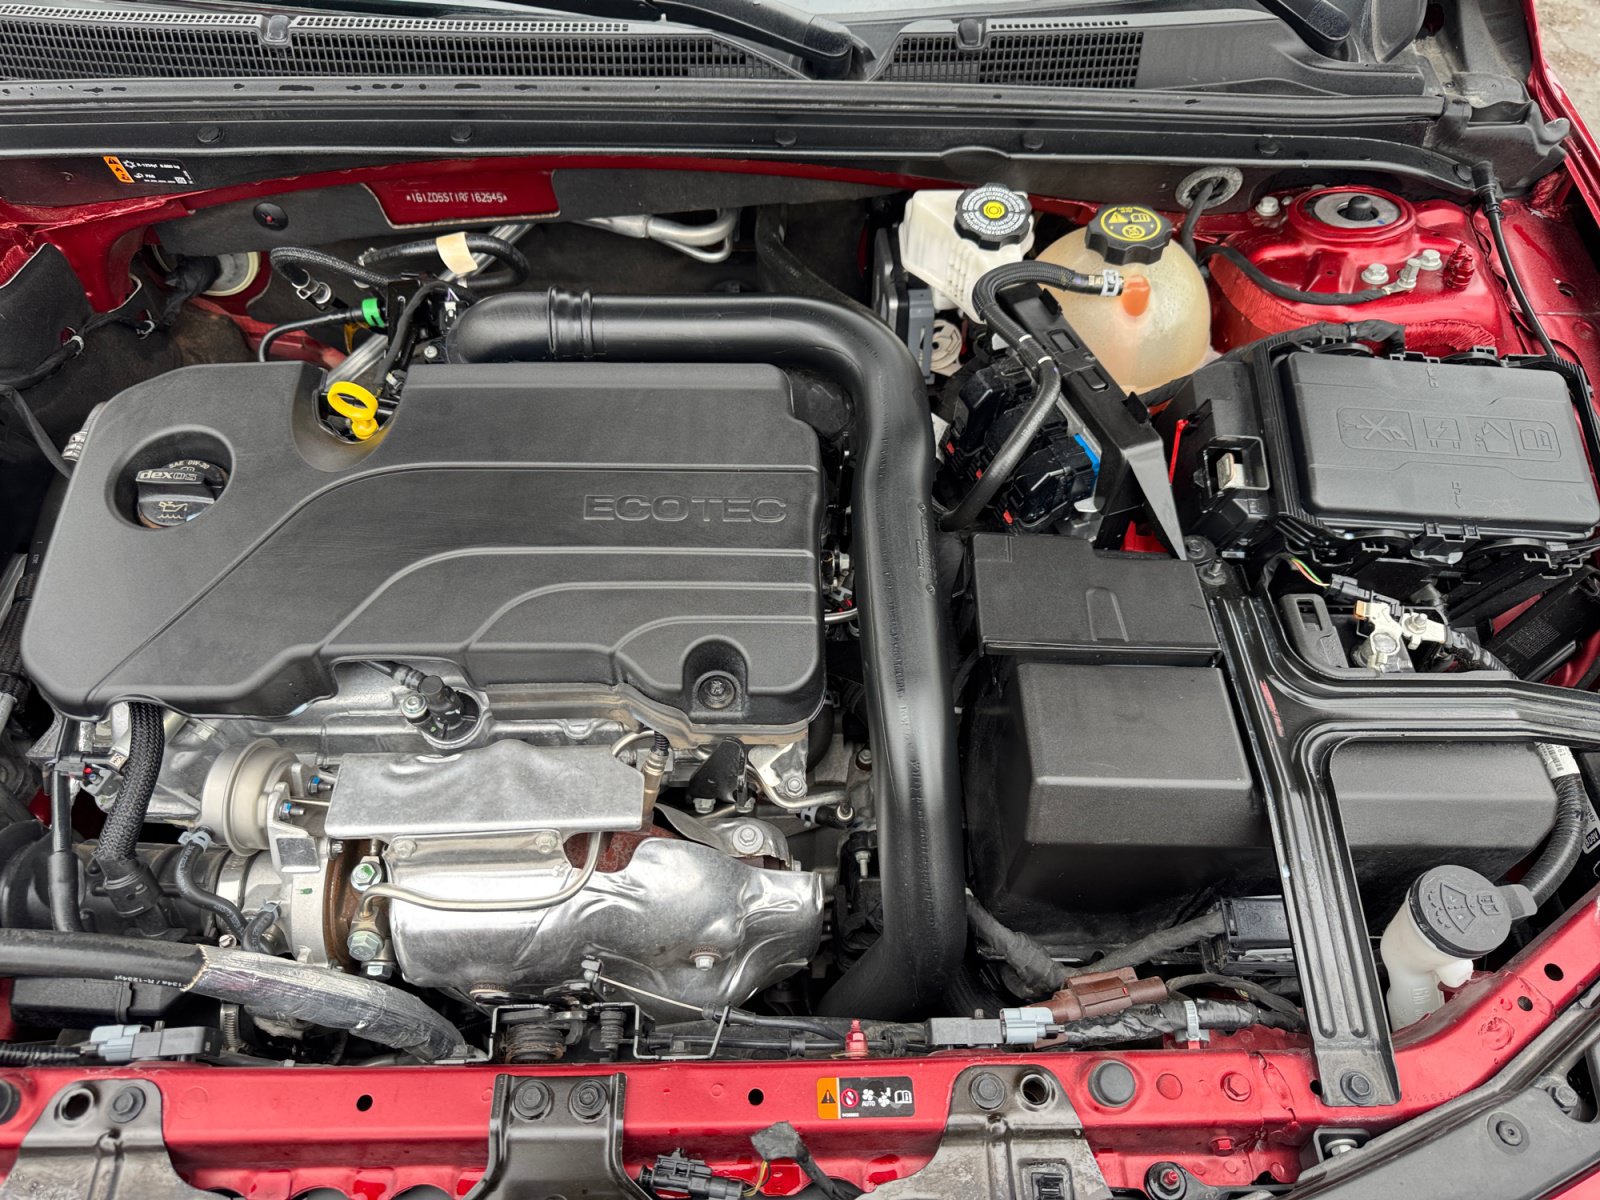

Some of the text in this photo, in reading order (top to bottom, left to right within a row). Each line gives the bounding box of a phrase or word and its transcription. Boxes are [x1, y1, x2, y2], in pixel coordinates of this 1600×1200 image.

[169, 461, 184, 469] SAE
[140, 470, 197, 481] dexos
[584, 495, 787, 523] ECOTEC
